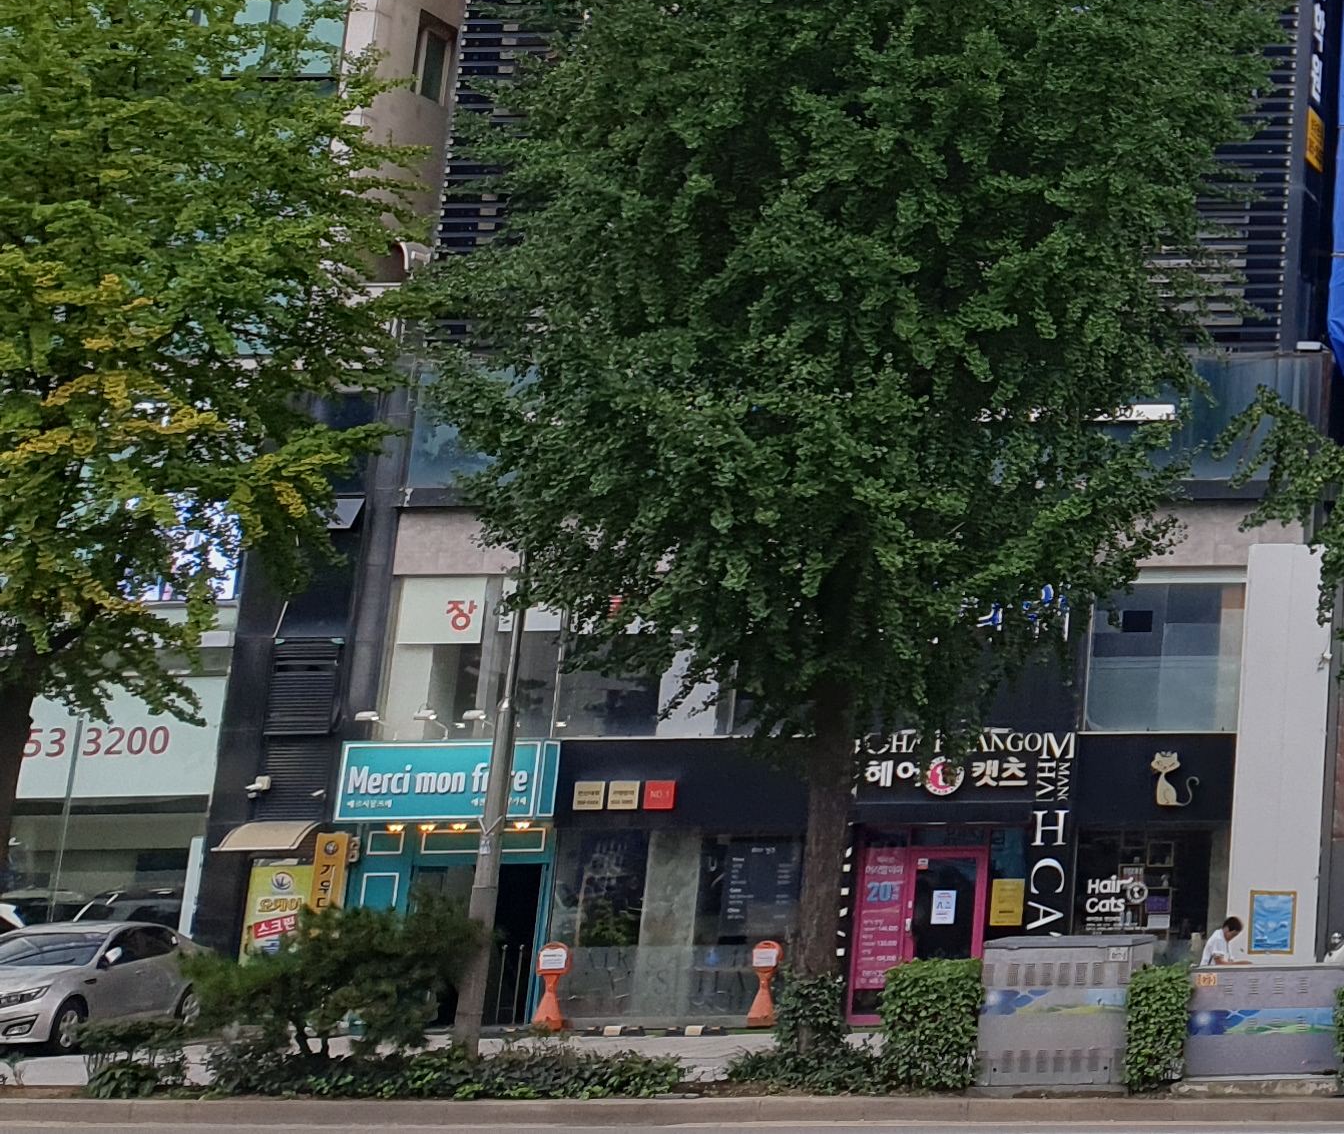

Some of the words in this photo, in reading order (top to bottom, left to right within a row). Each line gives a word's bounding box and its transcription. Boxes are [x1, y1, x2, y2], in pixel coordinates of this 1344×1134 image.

[82, 726, 170, 756] 3200
[346, 764, 412, 795] Merci
[414, 770, 466, 794] mon
[971, 757, 1028, 787] 캣츠
[1087, 875, 1134, 894] Hair
[1086, 896, 1125, 913] Cats
